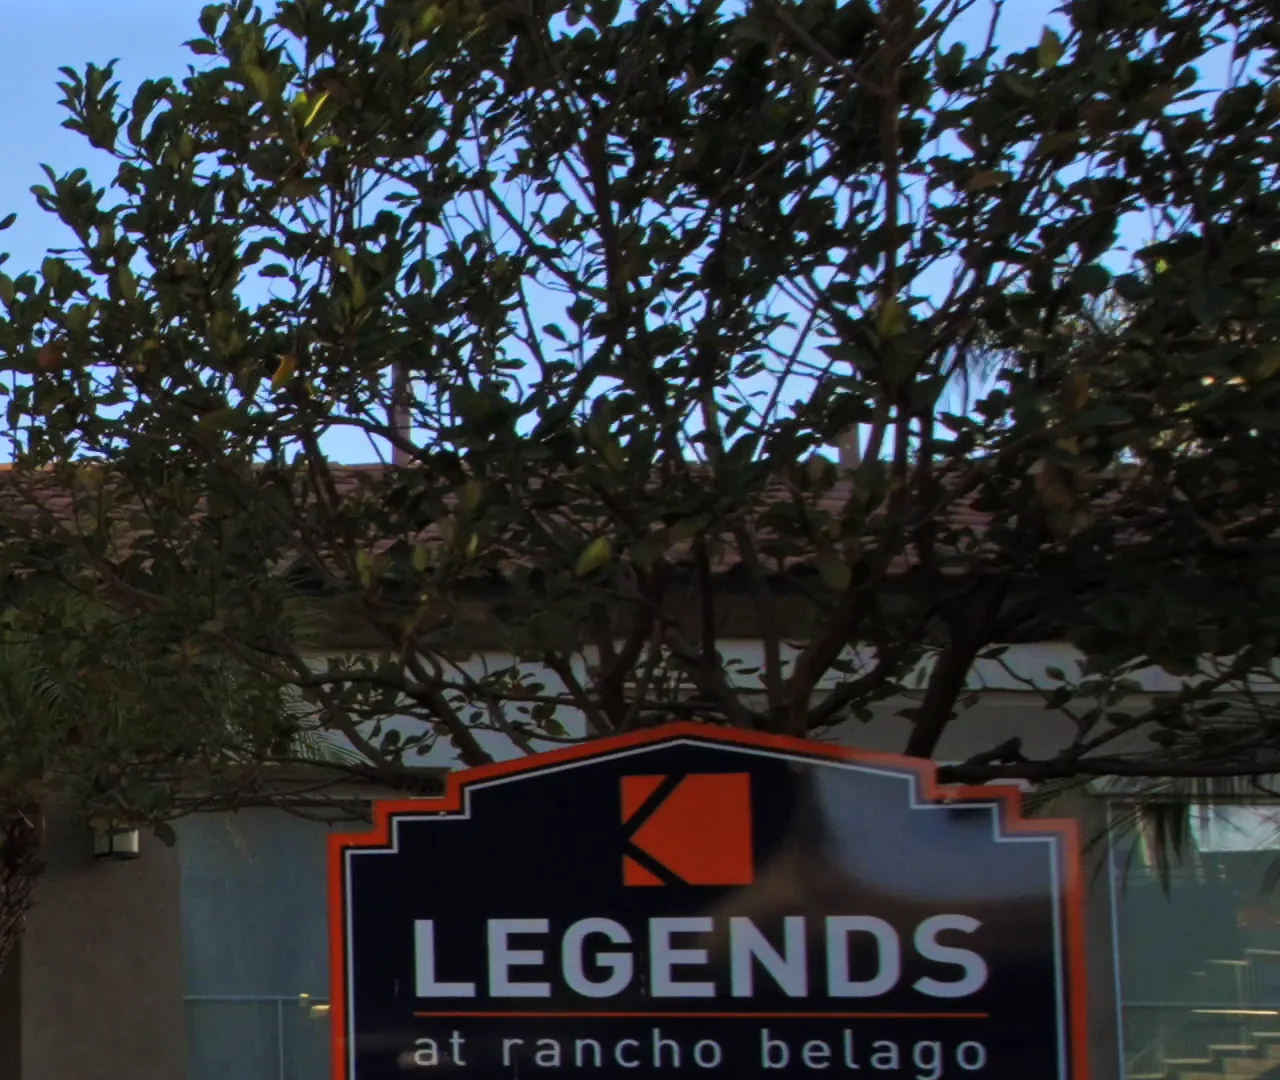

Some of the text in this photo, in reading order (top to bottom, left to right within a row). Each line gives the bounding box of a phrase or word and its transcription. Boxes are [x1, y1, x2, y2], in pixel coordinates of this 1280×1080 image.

[413, 914, 989, 998] LEGENDS
[413, 1030, 467, 1067] at
[501, 1027, 723, 1069] rancho
